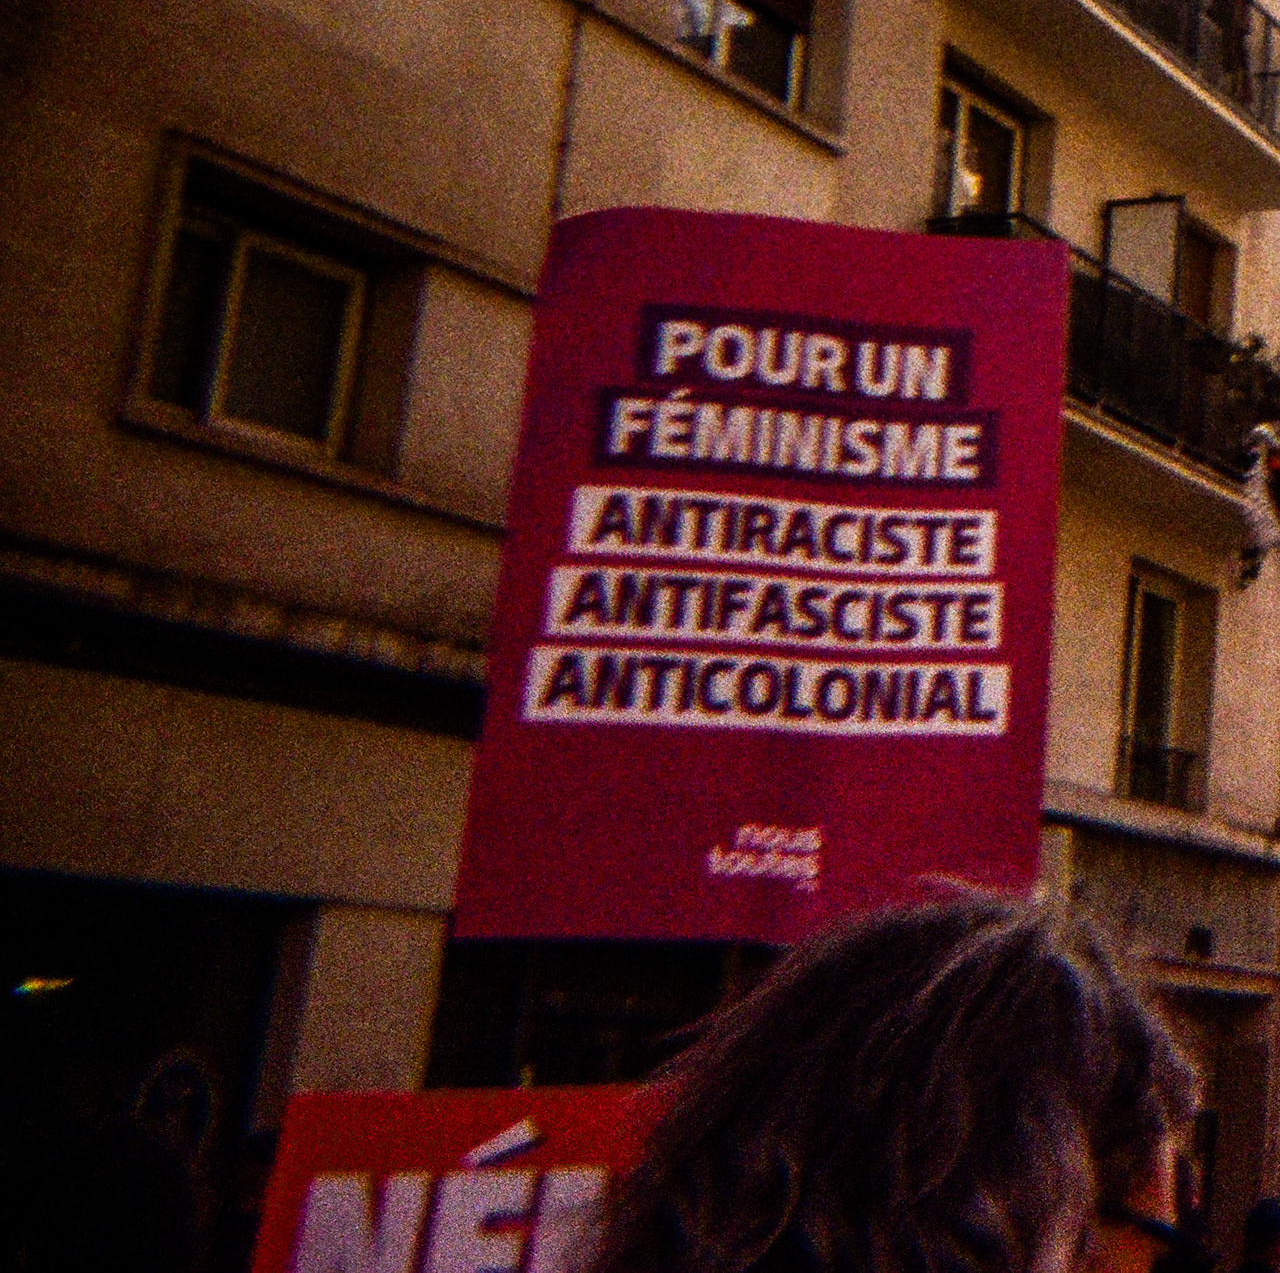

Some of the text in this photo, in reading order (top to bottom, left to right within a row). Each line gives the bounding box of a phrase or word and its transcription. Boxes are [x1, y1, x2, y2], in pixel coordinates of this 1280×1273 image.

[654, 320, 952, 401] POUR UN
[608, 388, 983, 481] FÉMINISME
[590, 493, 982, 566] ANTIRACISTE
[564, 571, 992, 643] ANTIFASCISTE
[545, 653, 999, 723] ANTICOLONIAL
